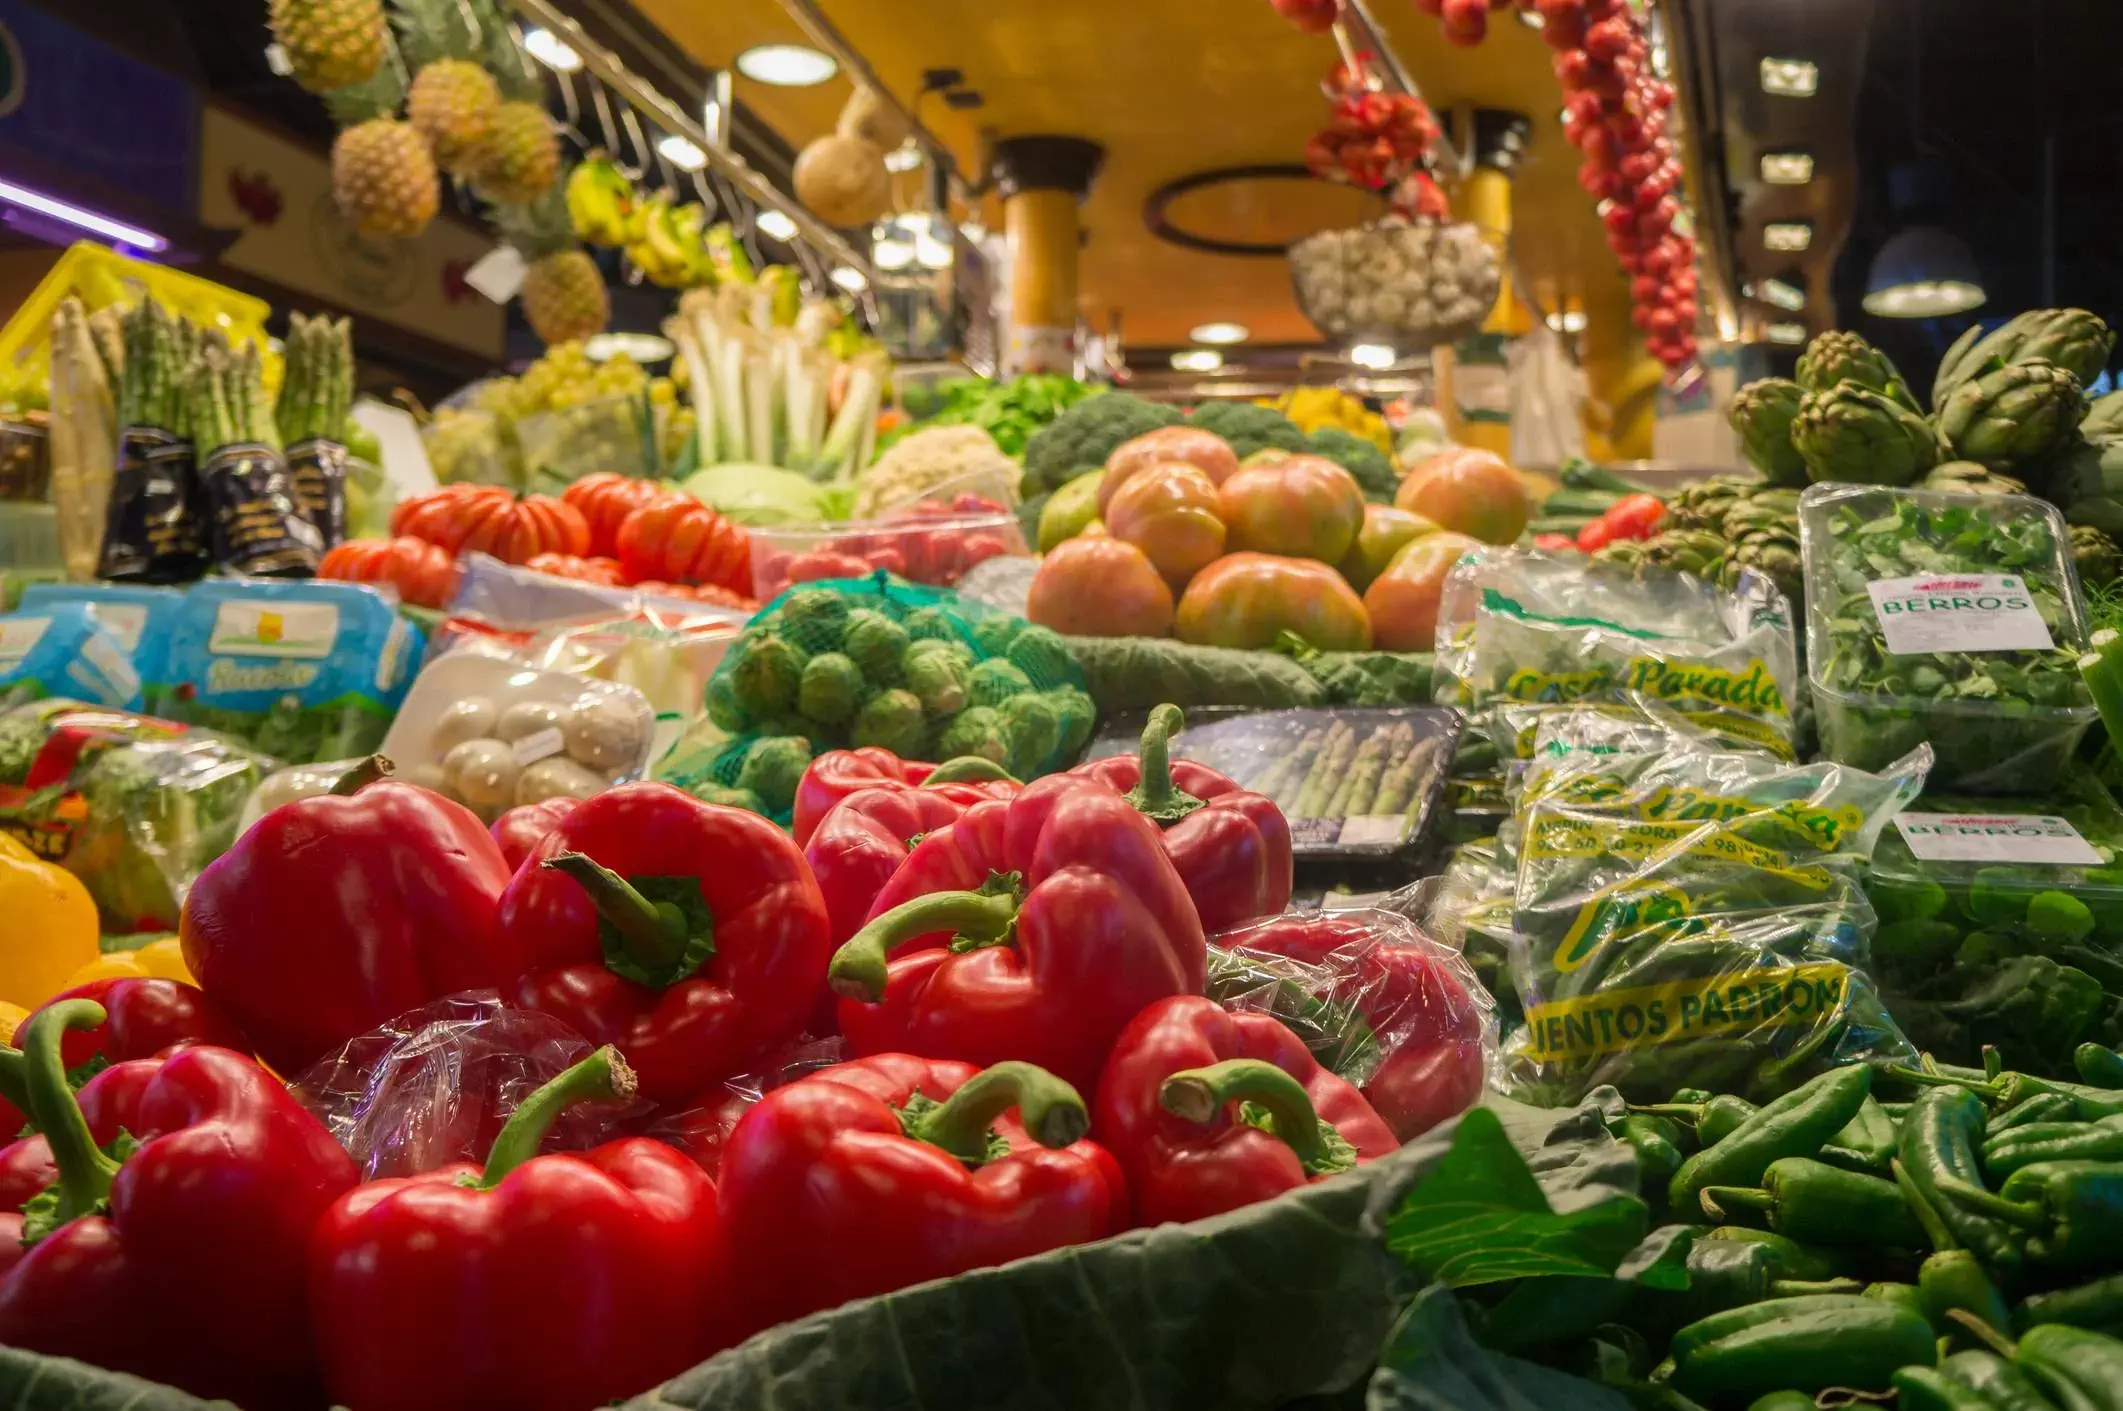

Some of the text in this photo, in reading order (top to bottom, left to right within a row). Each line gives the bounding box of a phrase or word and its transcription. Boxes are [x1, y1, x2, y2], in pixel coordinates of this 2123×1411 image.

[1883, 597, 2028, 614] BERROS
[1634, 660, 1783, 710] Parada
[1529, 1001, 1668, 1053] IENTOS
